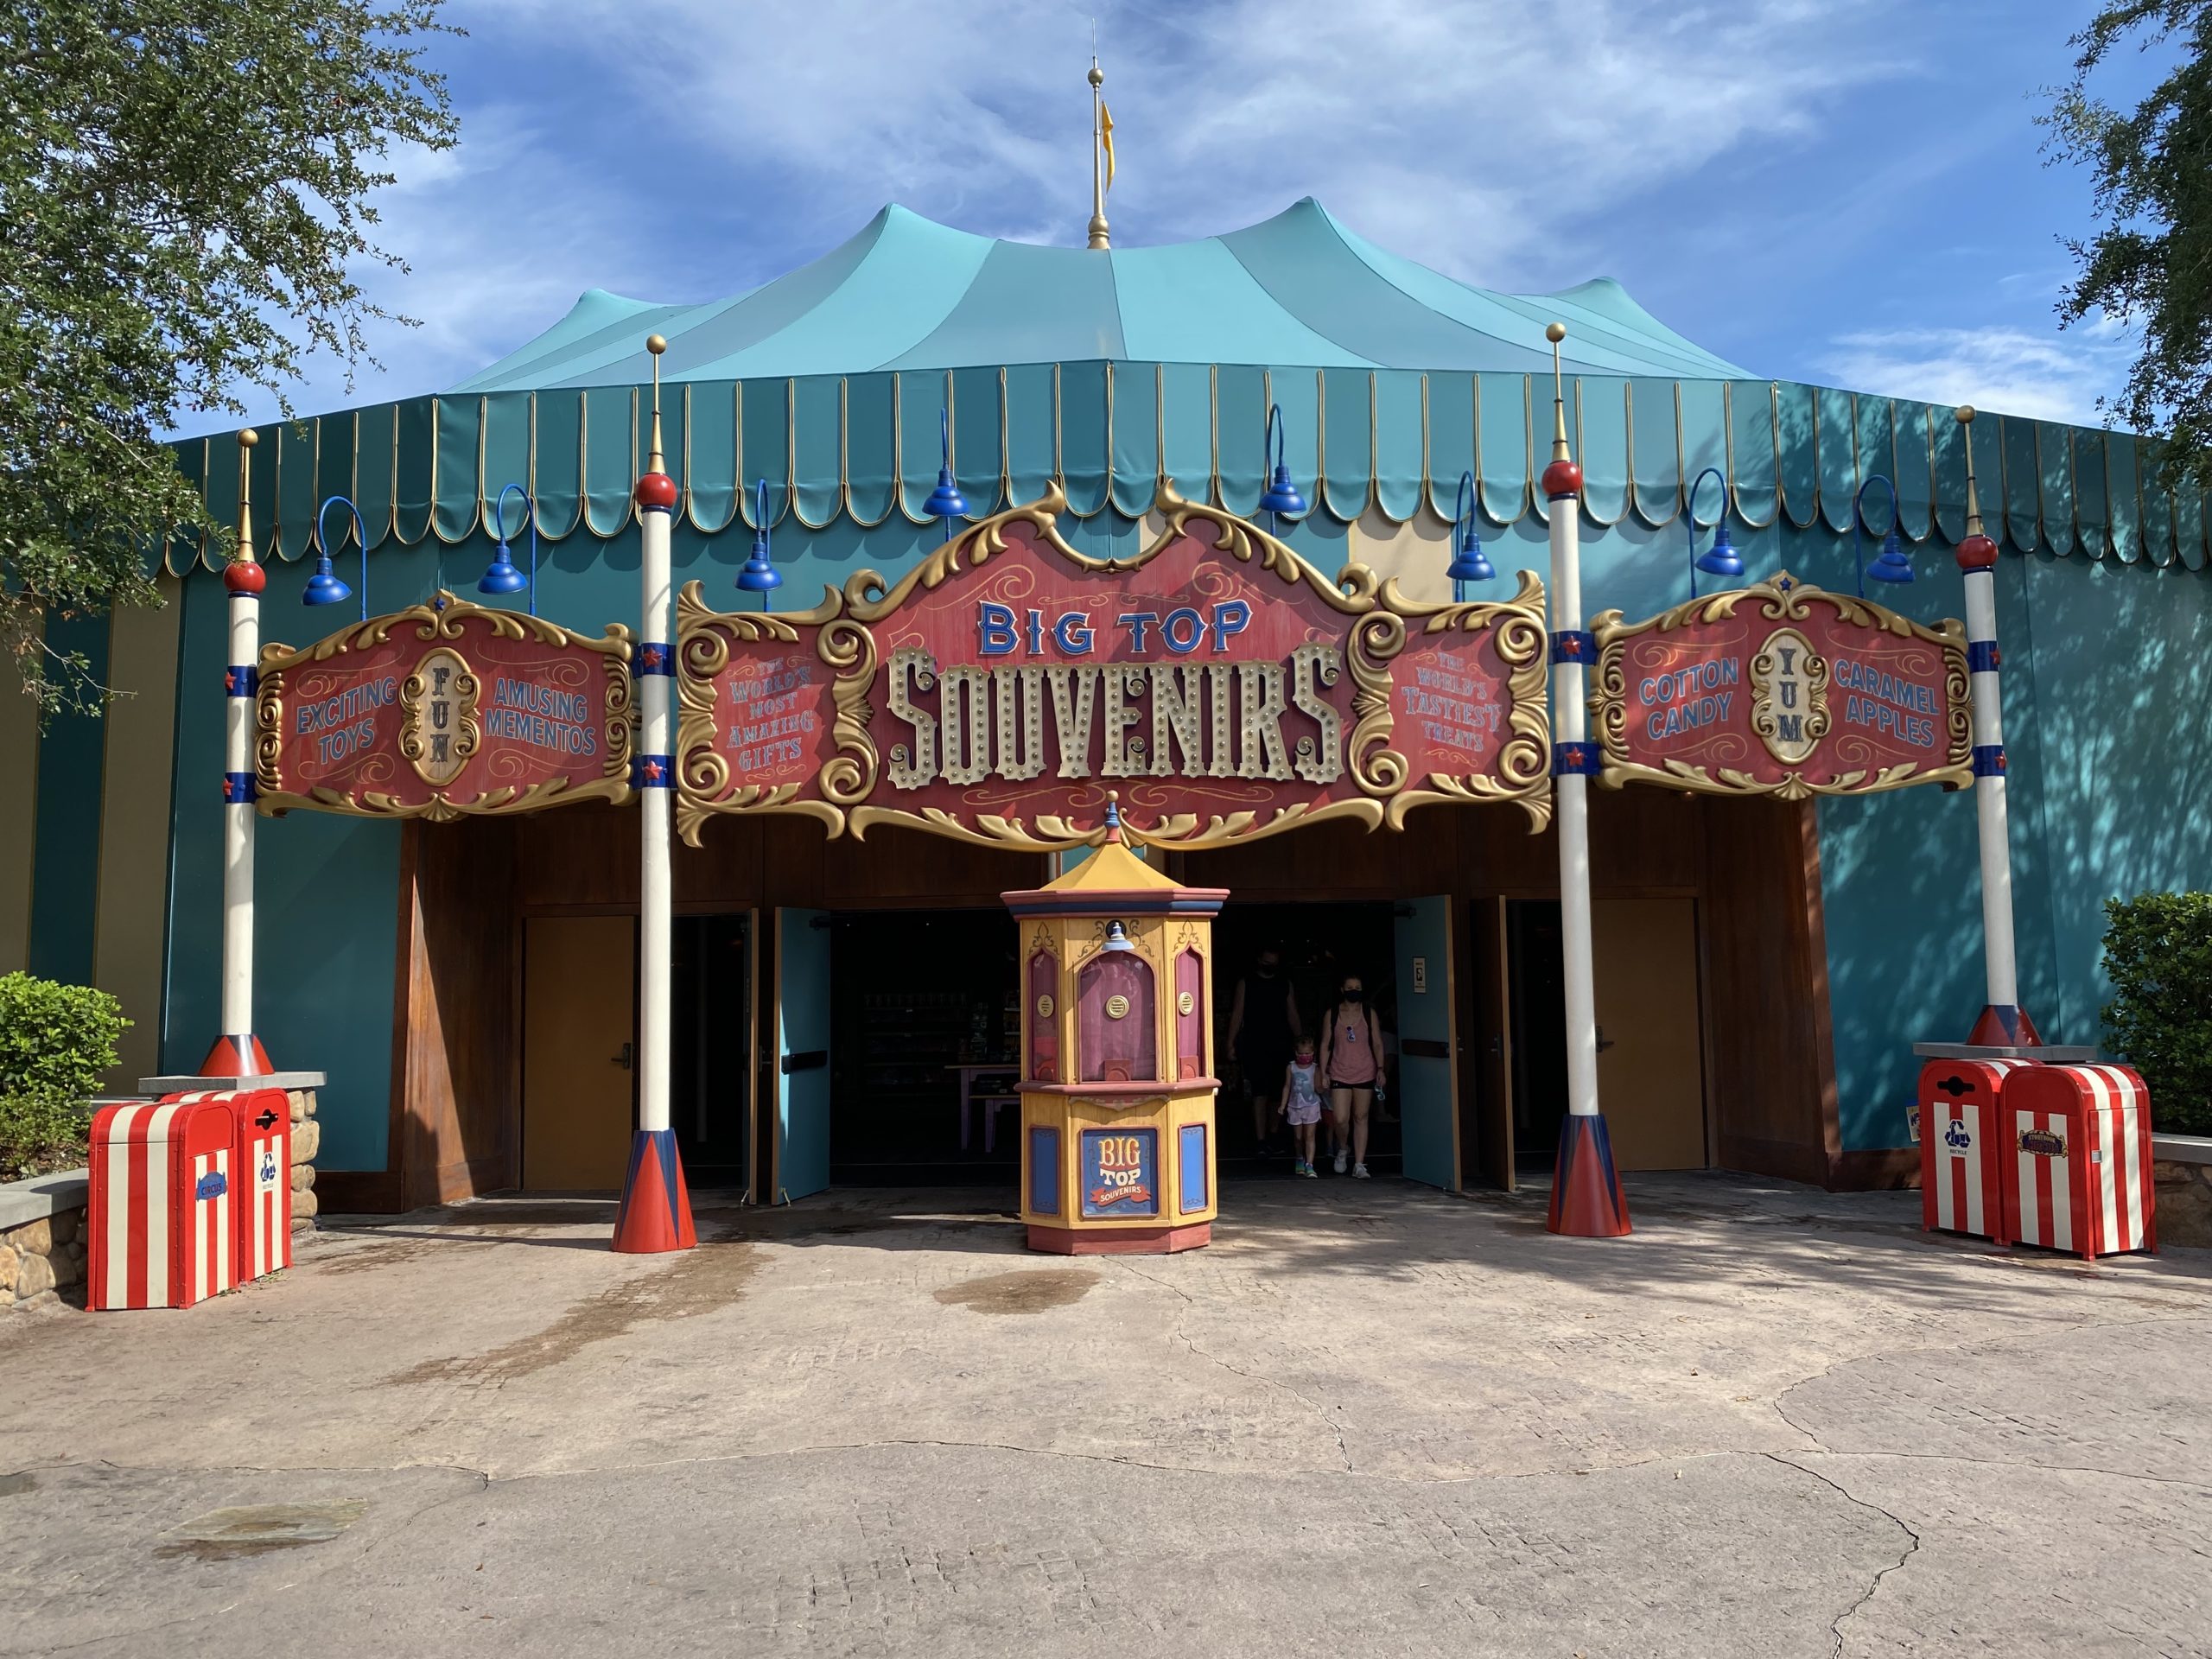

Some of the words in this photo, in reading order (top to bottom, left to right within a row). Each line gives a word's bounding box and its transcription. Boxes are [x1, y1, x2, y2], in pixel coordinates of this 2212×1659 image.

[976, 600, 1096, 655] BIG
[1116, 599, 1254, 653] TOP
[729, 665, 810, 703] WORLD'S
[757, 657, 784, 676] THE
[1416, 667, 1486, 700] WORLD'S
[1438, 652, 1465, 672] THE
[1639, 657, 1738, 706] COTTON
[296, 676, 397, 734] EXCITING
[493, 677, 588, 723] AMUSING
[749, 691, 798, 720] MOST
[1402, 686, 1502, 732] TASTIEST
[1777, 647, 1804, 743] YUM
[1834, 659, 1940, 715] CARAMEL
[429, 667, 449, 763] FUN
[485, 709, 595, 757] MEMENTOS
[727, 710, 814, 748] AMAZING
[887, 642, 1345, 790] SOUVENIRS
[1421, 720, 1484, 752] TREATS
[1647, 692, 1733, 741] CANDY
[1845, 696, 1935, 747] APPLES
[319, 718, 375, 766] TOYS
[739, 737, 802, 772] GIFTS
[1098, 1136, 1141, 1166] BIG
[200, 1182, 222, 1196] CIRCUS
[1100, 1168, 1141, 1186] TOP
[1100, 1185, 1141, 1202] SOUVENIRS
